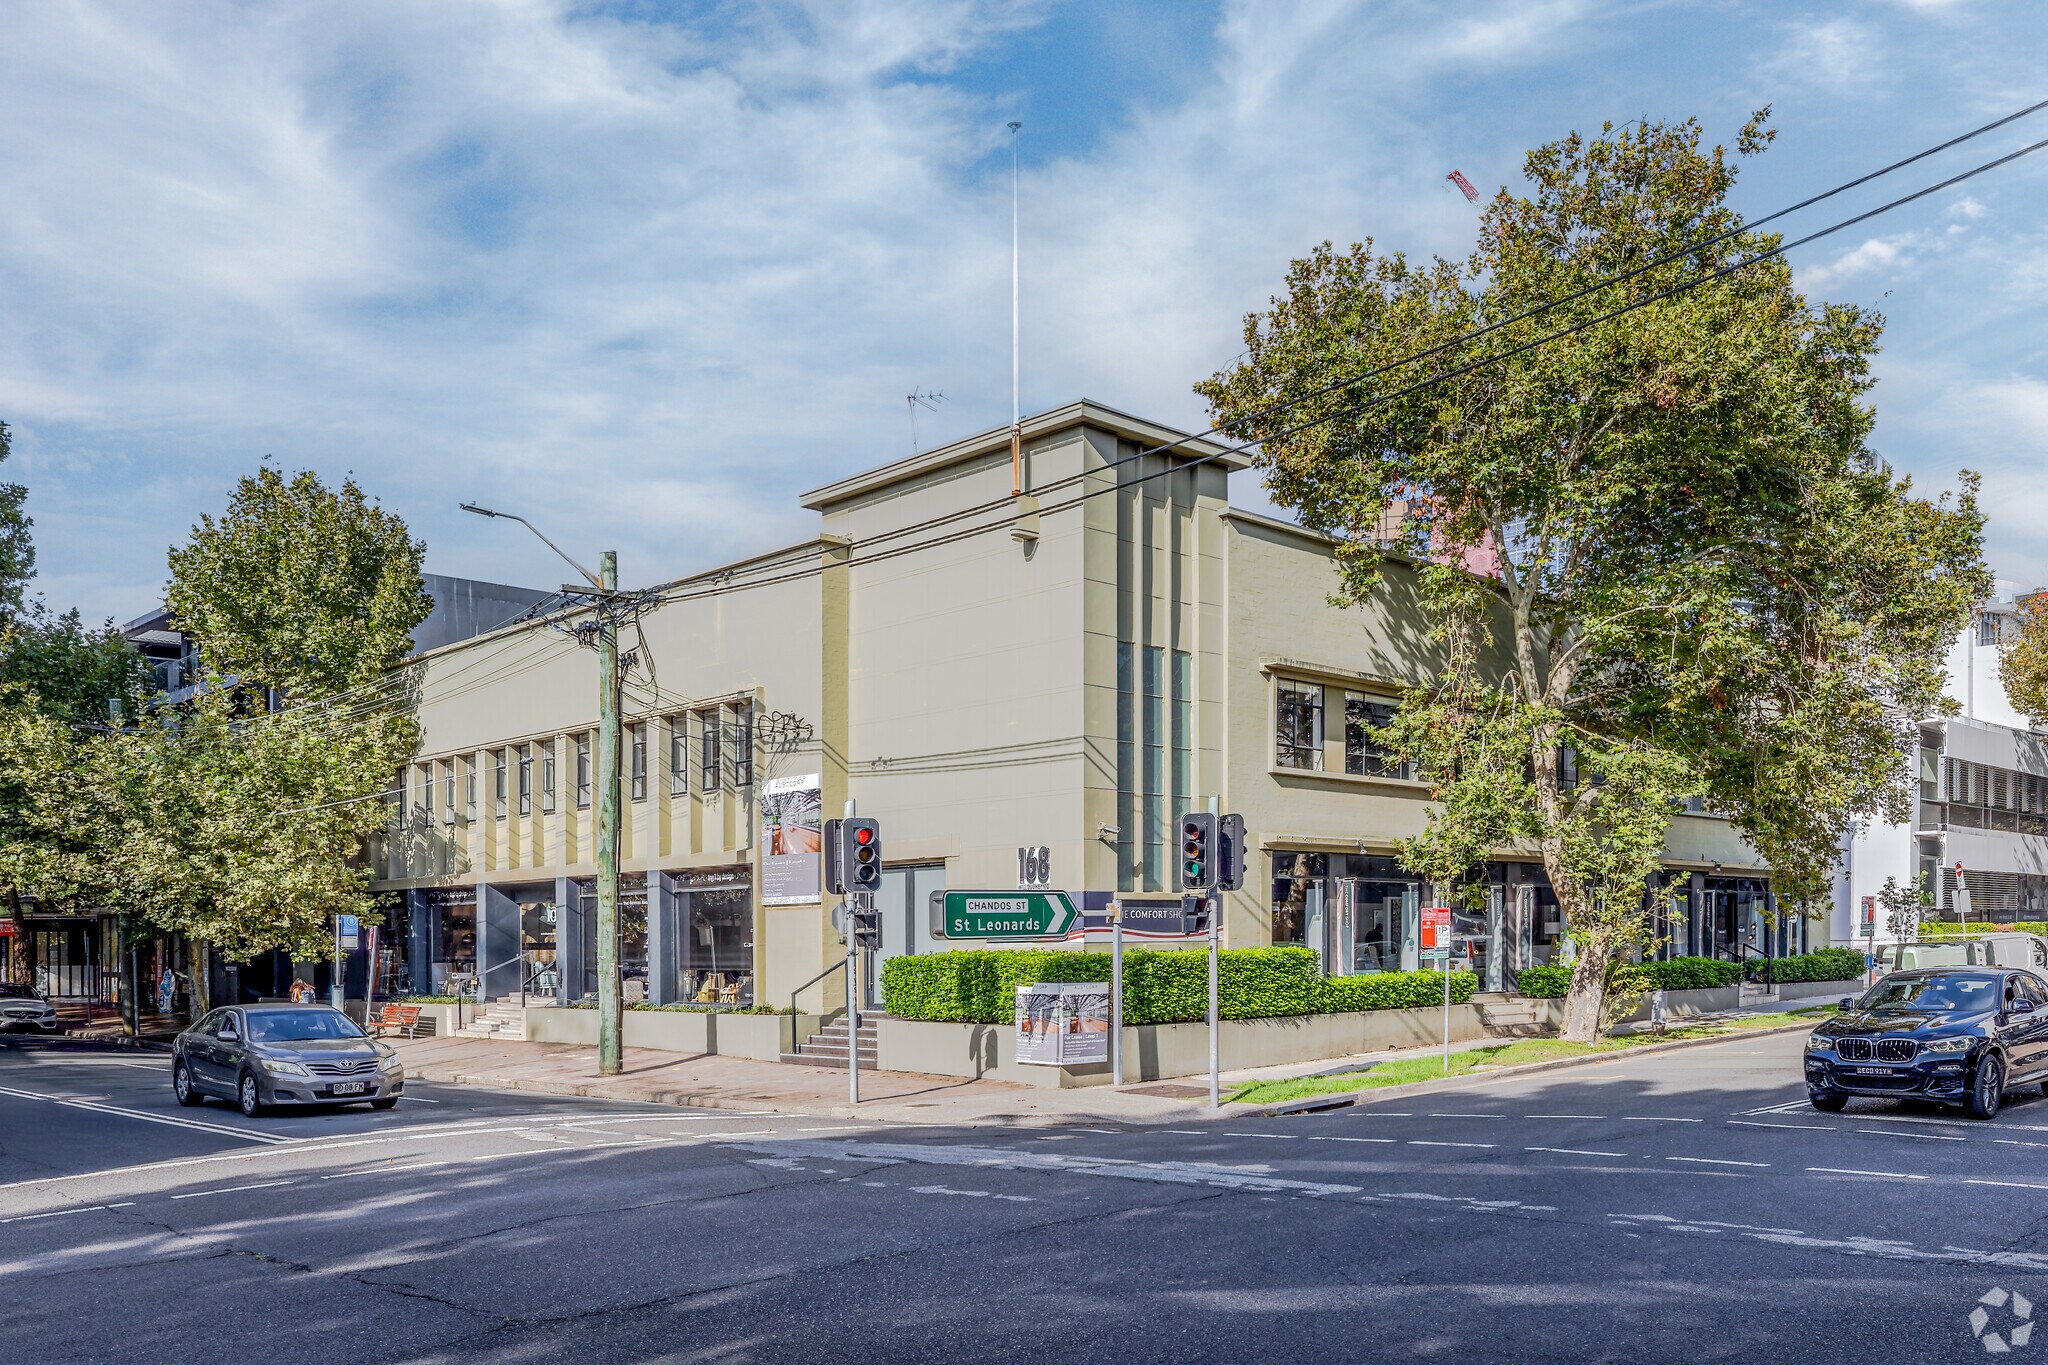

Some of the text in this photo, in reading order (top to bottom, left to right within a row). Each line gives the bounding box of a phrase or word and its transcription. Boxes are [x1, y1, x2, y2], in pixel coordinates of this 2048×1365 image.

[1018, 846, 1050, 884] 168
[968, 901, 1026, 910] CHANDOS ST
[1130, 910, 1167, 919] COMFORT
[1169, 910, 1183, 919] SHO
[954, 918, 1040, 931] St Leonards
